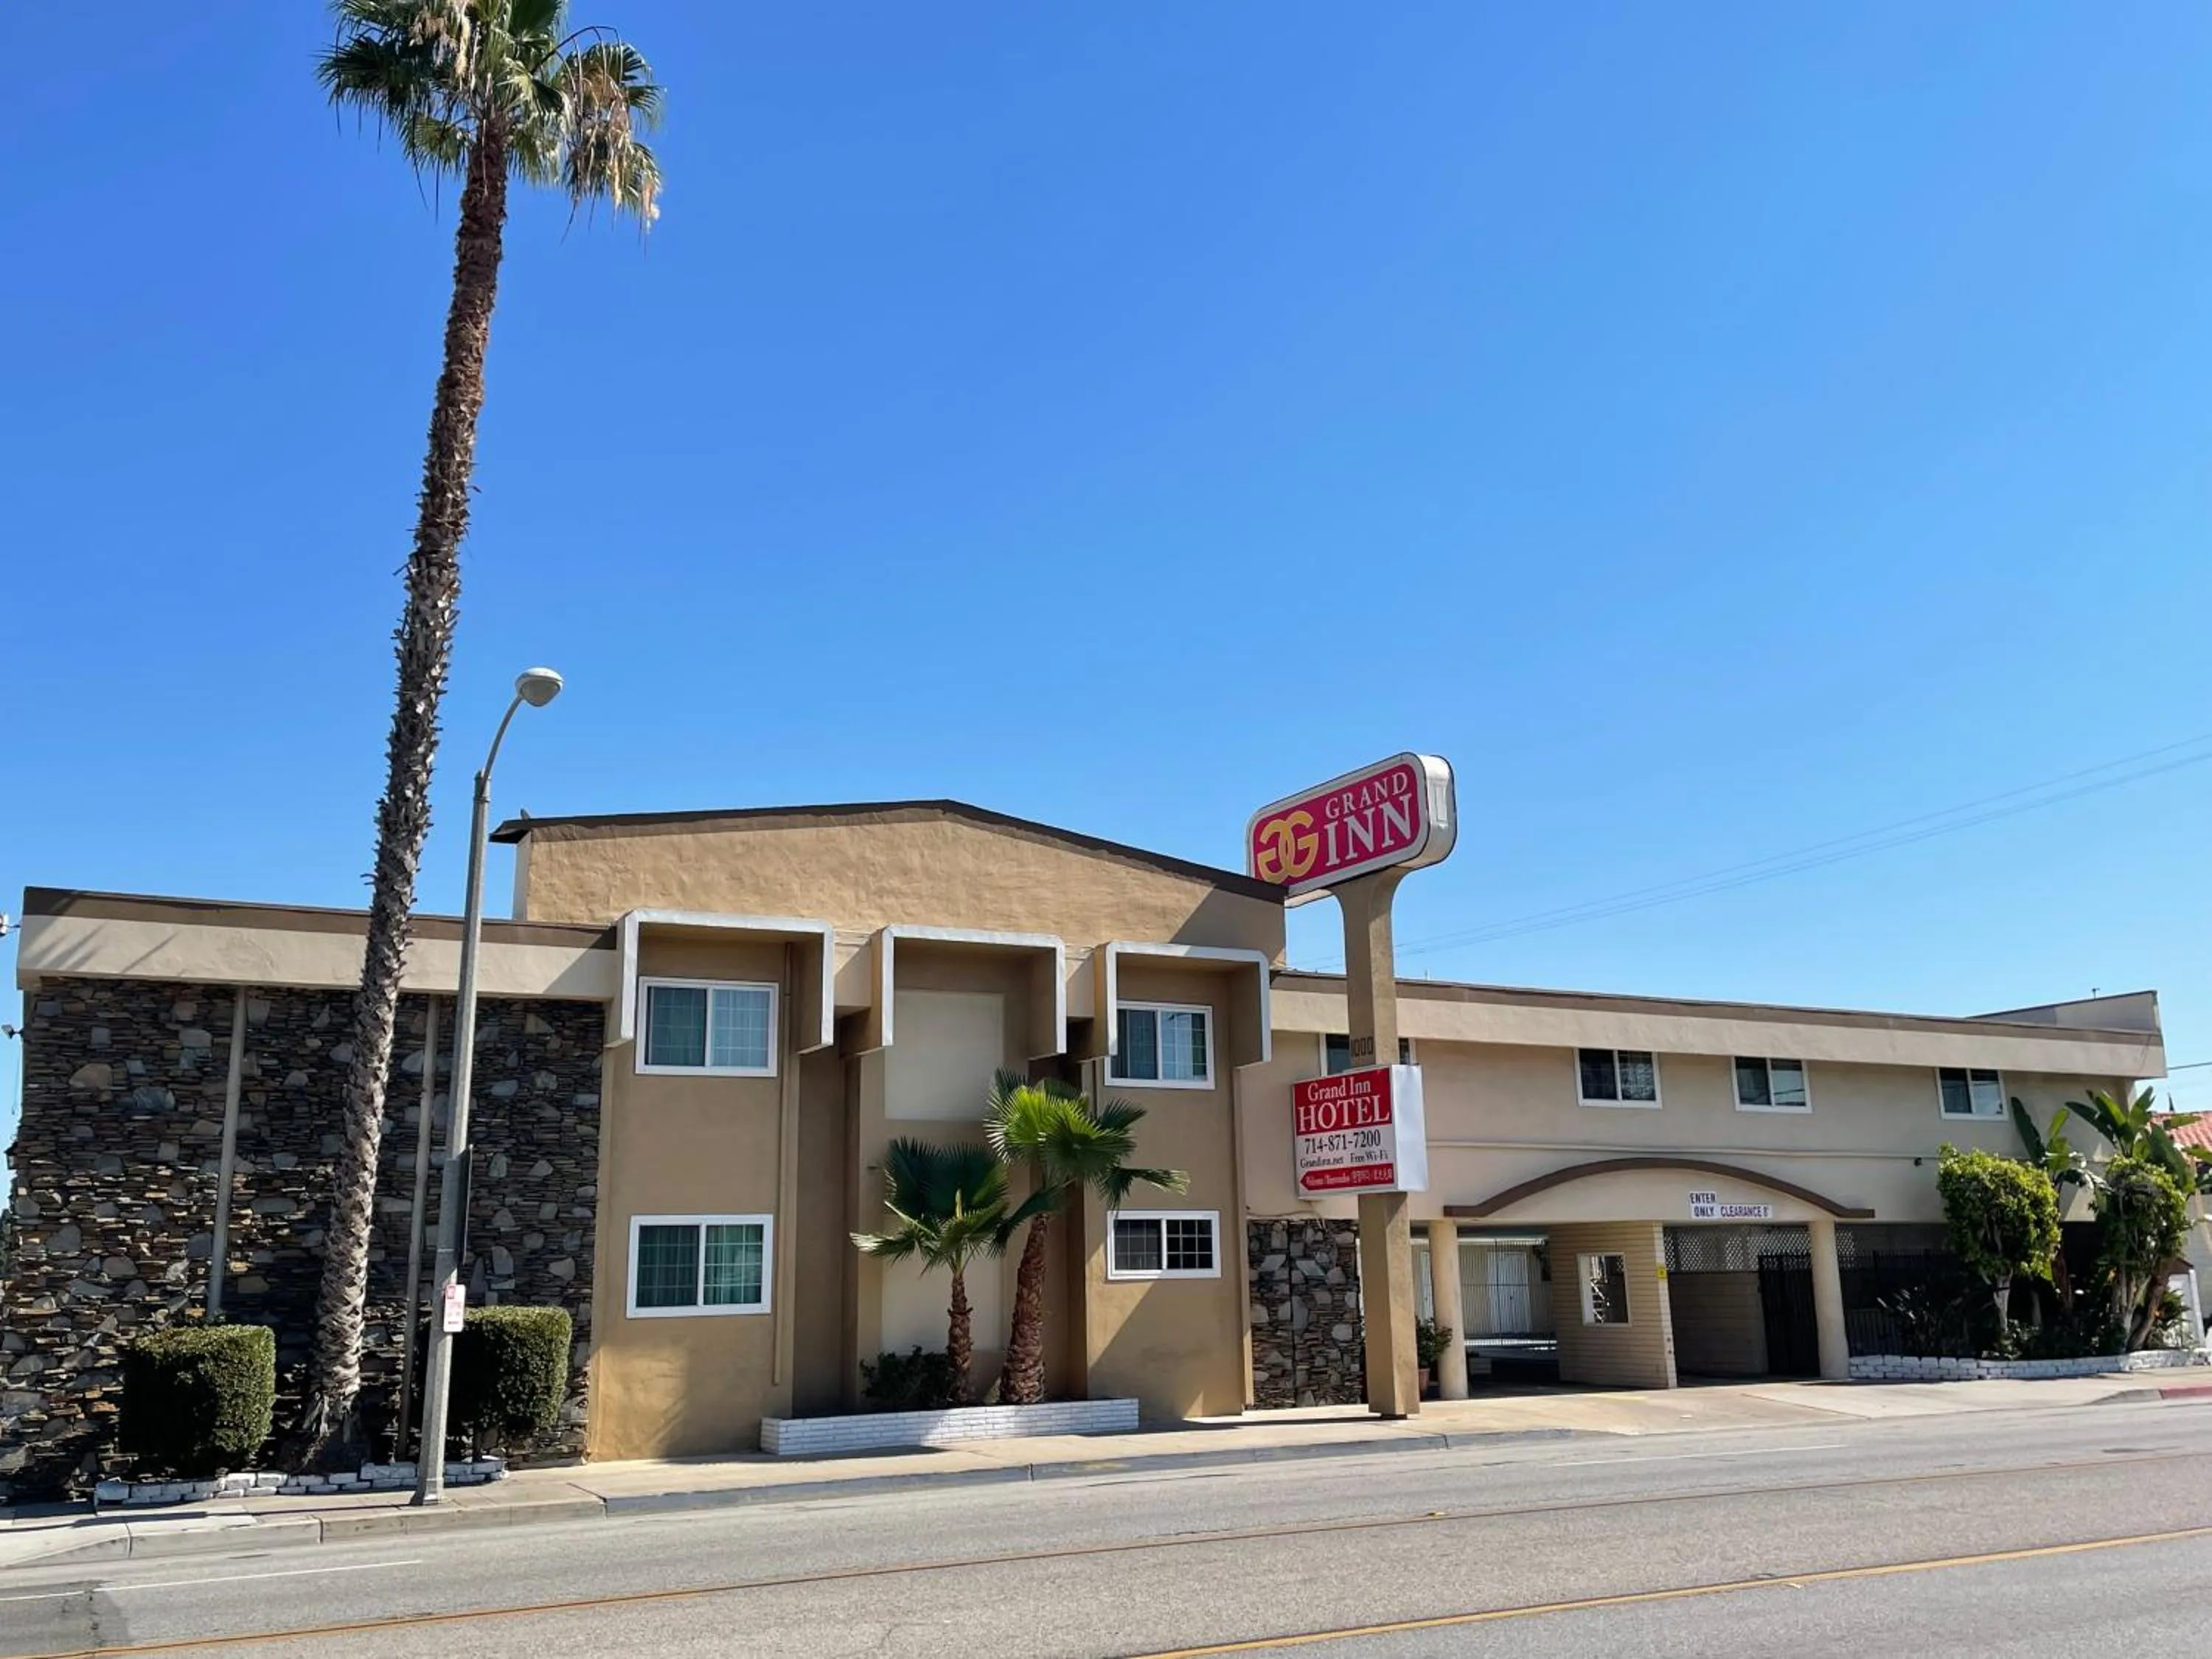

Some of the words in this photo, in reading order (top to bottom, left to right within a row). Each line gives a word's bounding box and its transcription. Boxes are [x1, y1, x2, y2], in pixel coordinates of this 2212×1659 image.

[1325, 772, 1408, 819] GRAND
[1324, 793, 1412, 866] INN
[1307, 1077, 1346, 1102] Grand
[1349, 1076, 1371, 1095] Inn
[1298, 1095, 1390, 1132] HOTEL
[1304, 1129, 1381, 1154] 714-871-7200
[1690, 1192, 1716, 1204] ENTER
[1694, 1206, 1714, 1217] ONLY
[1720, 1206, 1761, 1217] CLEARANCE
